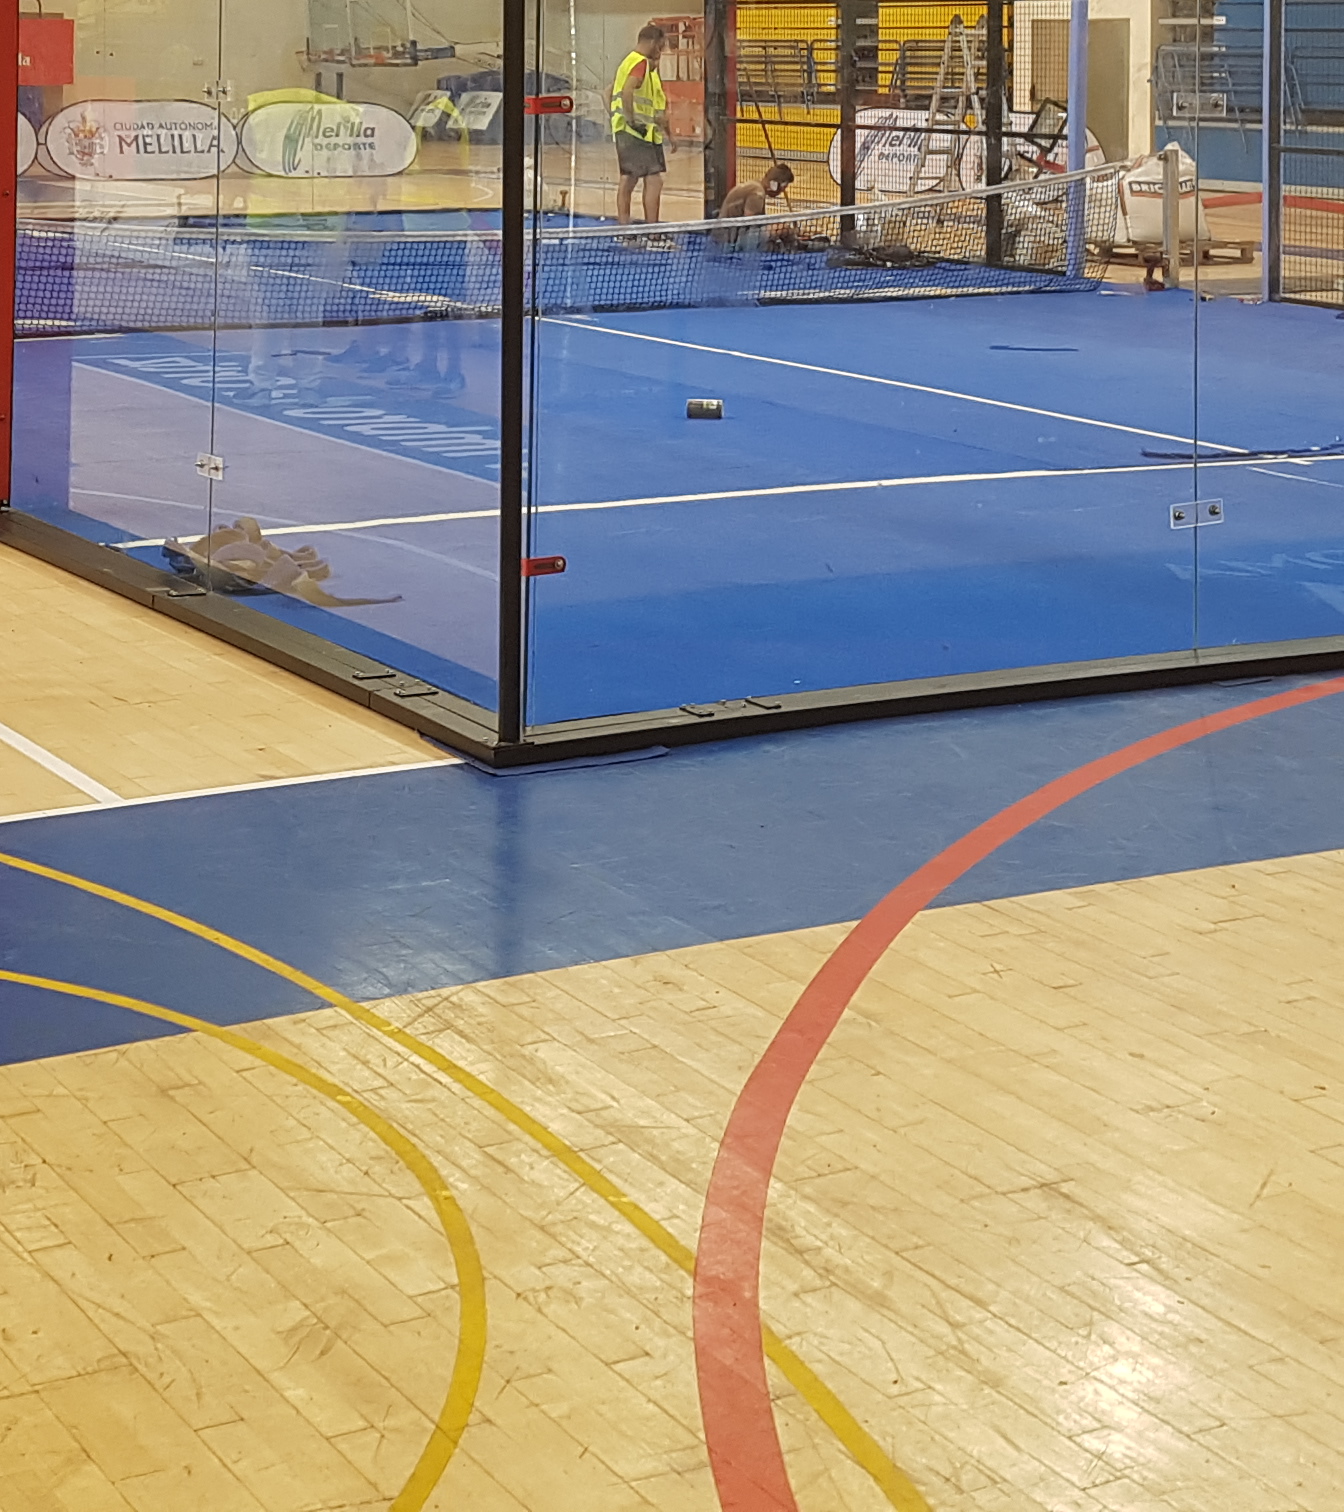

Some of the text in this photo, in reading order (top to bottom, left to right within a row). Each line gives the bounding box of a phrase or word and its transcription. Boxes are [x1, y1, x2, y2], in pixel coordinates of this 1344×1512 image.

[113, 120, 219, 131] CIUDAD AUTÓNOM
[118, 133, 225, 156] MELILLA
[313, 141, 376, 152] DEPORTE
[877, 151, 919, 164] DEPORT
